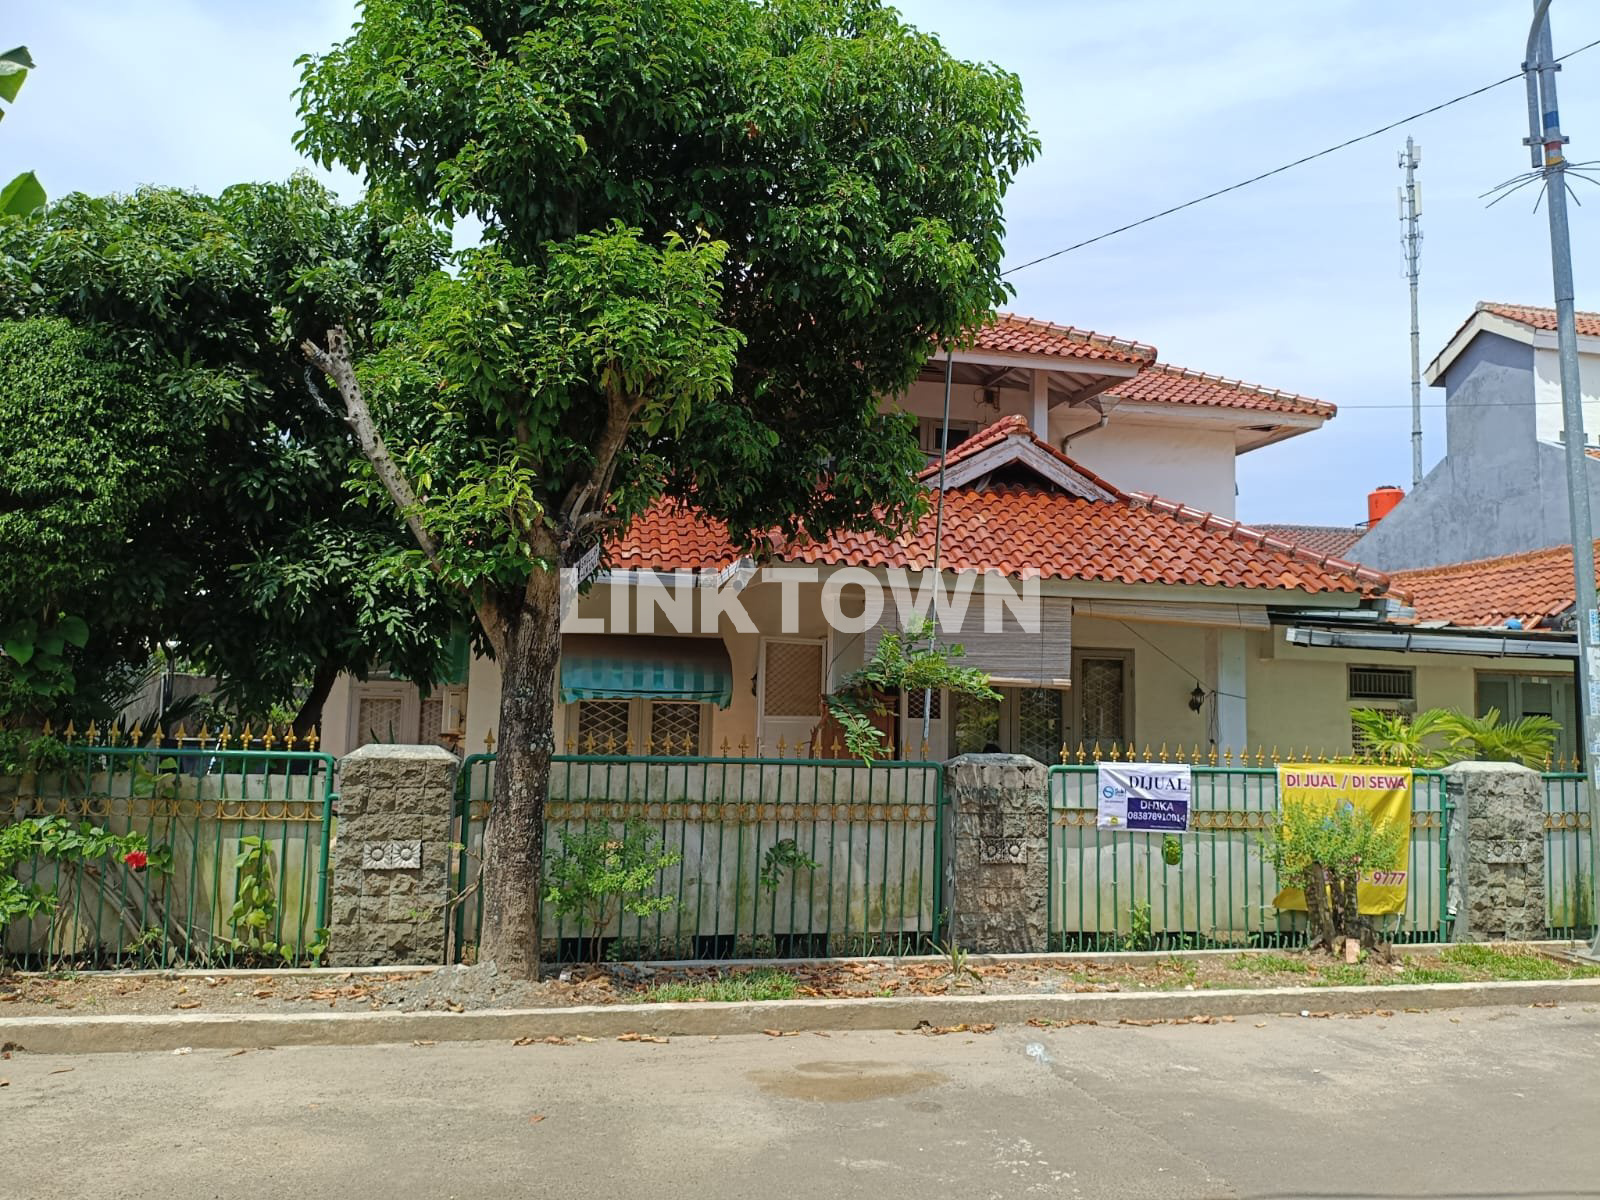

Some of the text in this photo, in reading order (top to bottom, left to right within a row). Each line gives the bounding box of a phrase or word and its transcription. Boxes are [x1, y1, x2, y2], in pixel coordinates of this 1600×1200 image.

[1129, 775, 1187, 791] DIJUAL
[1286, 774, 1406, 789] DI JUAL / DI SEWA
